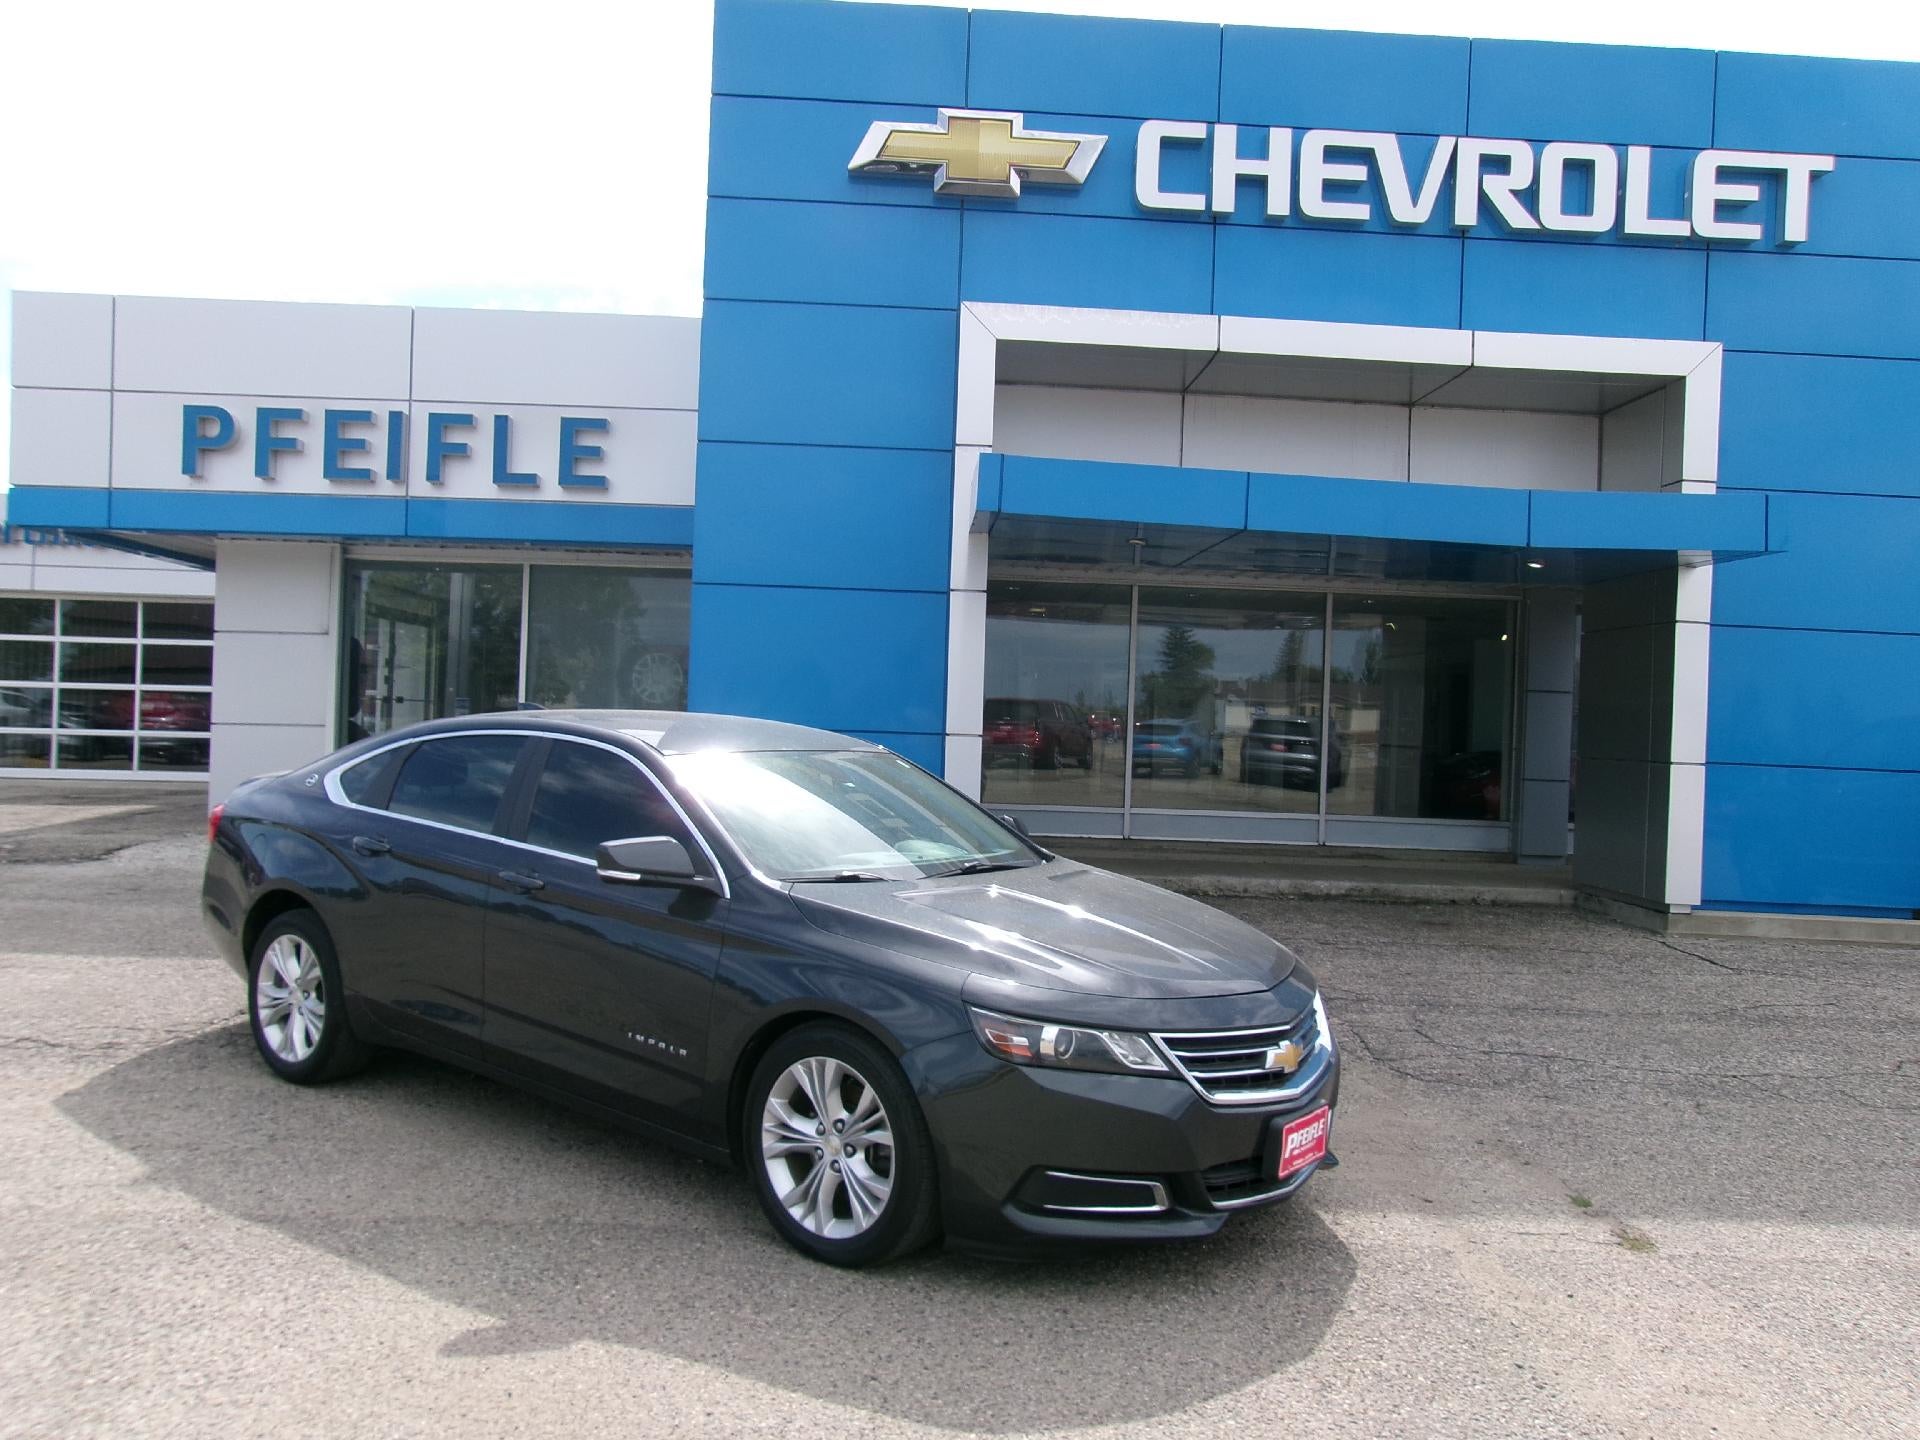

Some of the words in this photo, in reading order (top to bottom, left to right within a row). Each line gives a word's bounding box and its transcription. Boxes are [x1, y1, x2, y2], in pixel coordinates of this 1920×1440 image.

[1135, 119, 1836, 246] CHEVROLET
[181, 404, 611, 491] PFEIFLE
[627, 1031, 688, 1057] IMPALA
